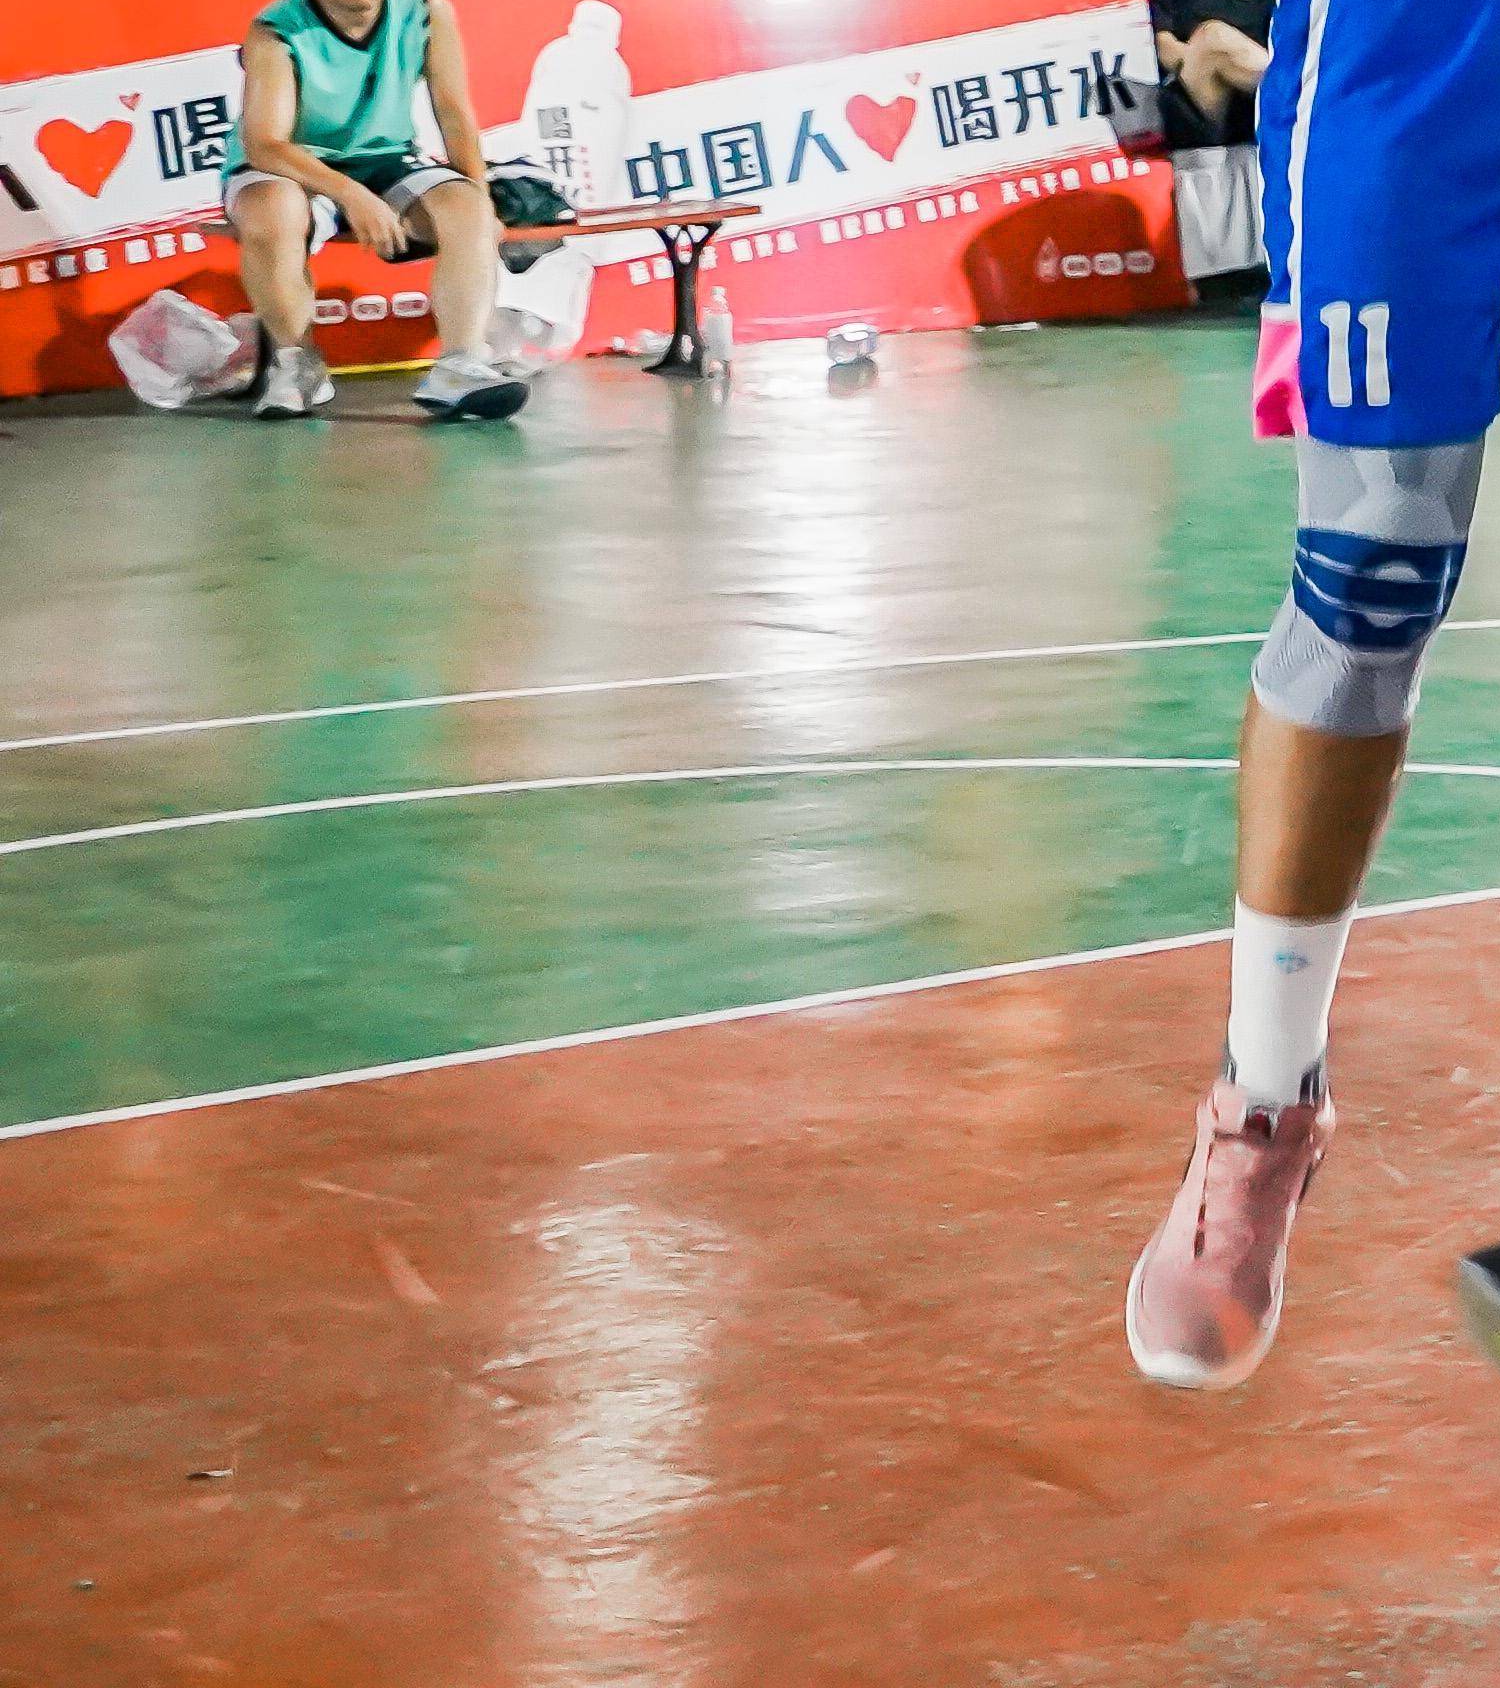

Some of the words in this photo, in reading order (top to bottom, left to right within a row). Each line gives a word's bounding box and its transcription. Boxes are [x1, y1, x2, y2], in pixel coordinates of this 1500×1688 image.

[930, 49, 1137, 149] 喝开水
[624, 108, 851, 202] 中国人
[1320, 301, 1391, 408] 11
